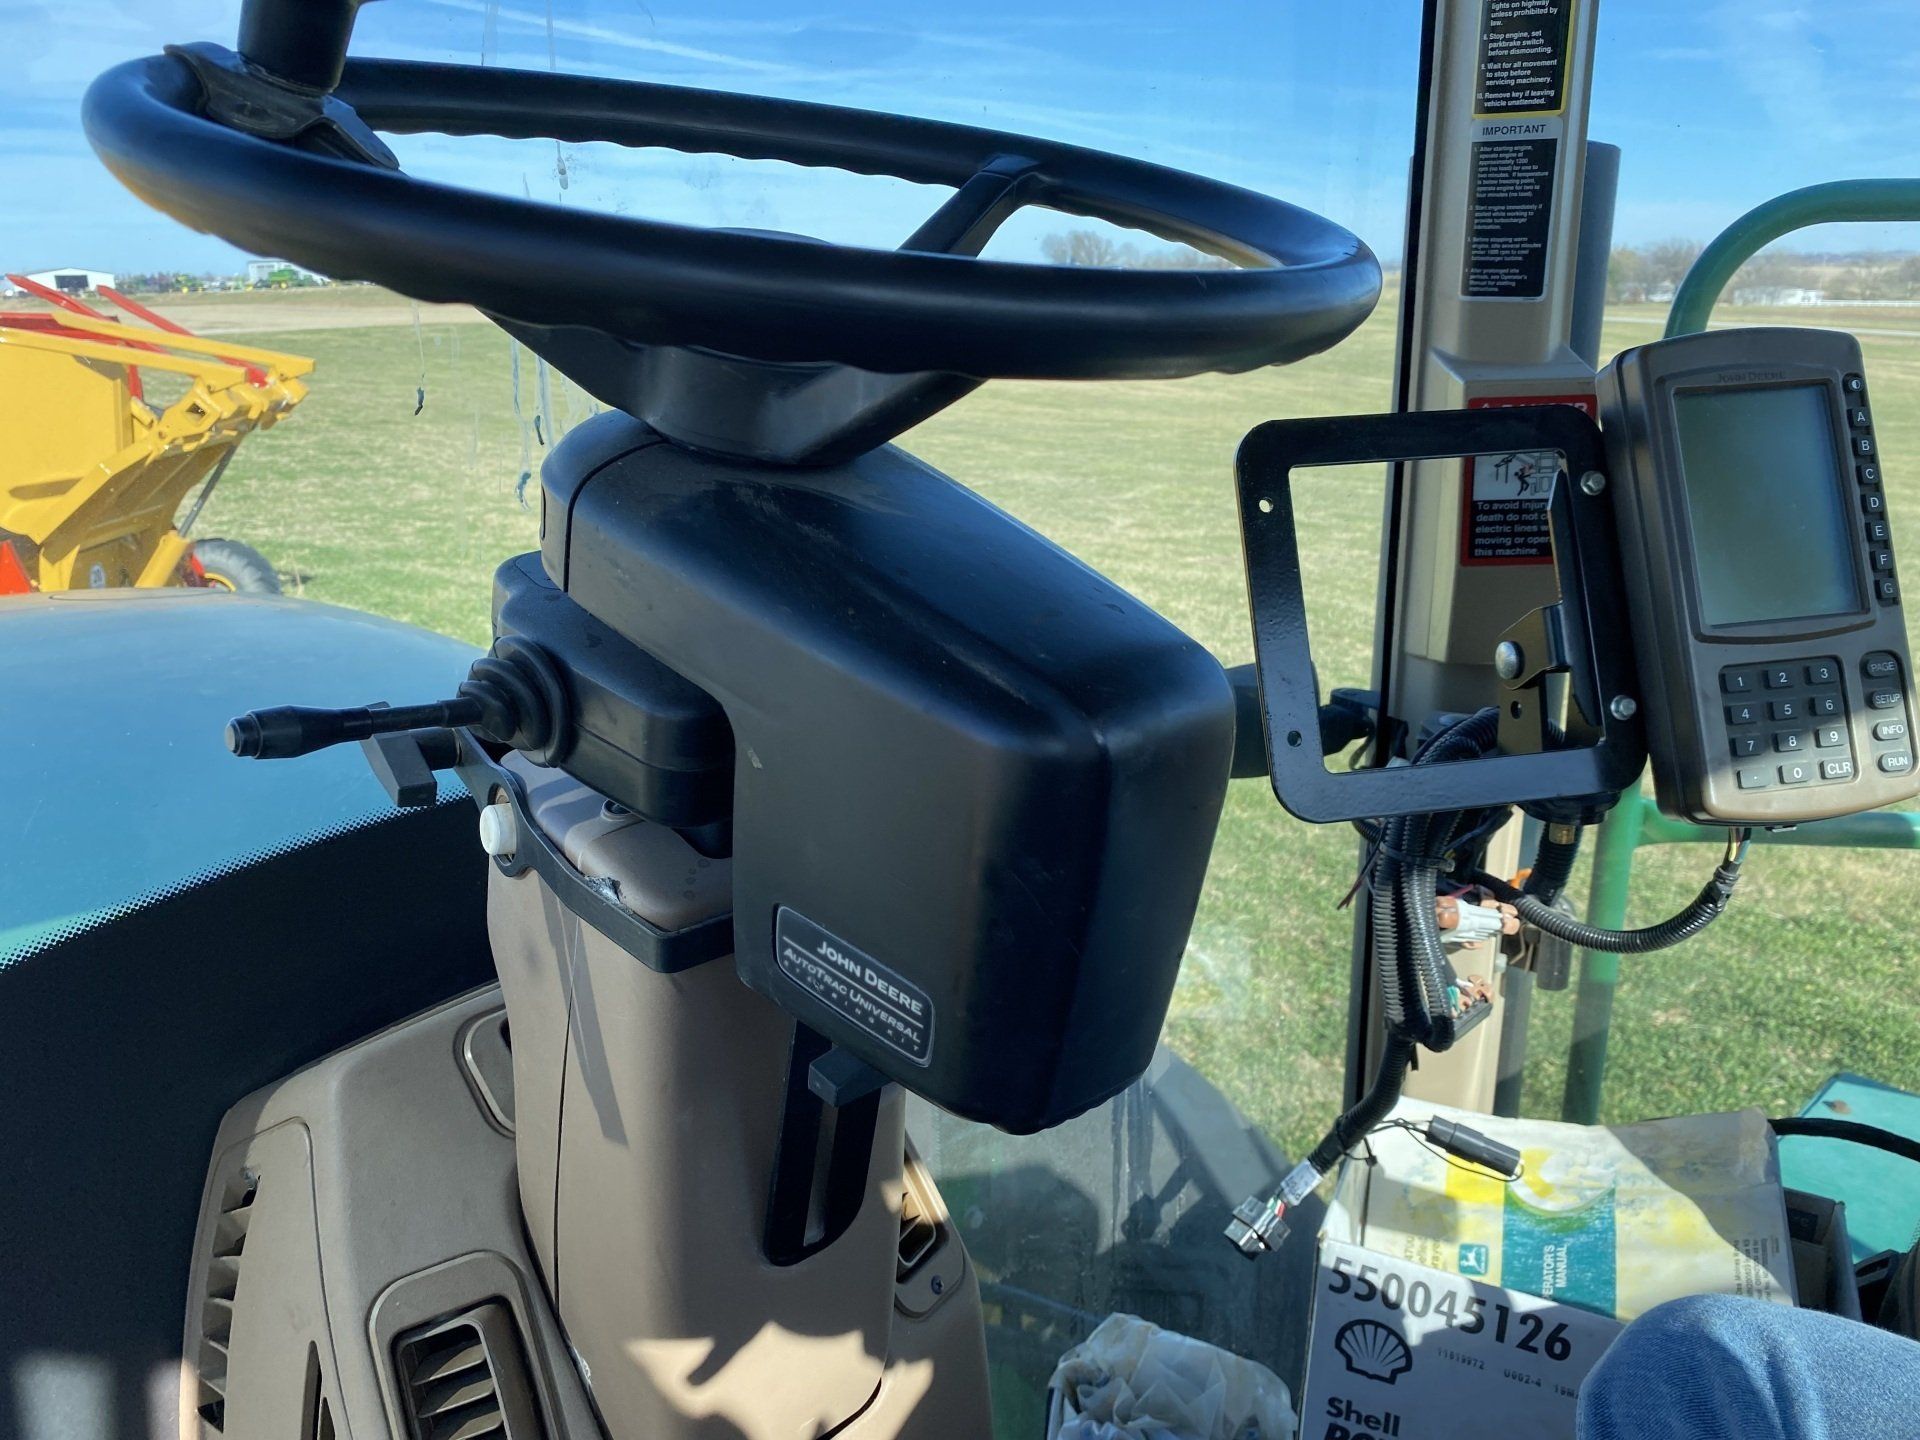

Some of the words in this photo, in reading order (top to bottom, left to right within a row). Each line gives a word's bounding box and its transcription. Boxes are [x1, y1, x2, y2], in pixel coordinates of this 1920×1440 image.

[1492, 2, 1510, 10] lights
[1521, 0, 1550, 8] highway
[1513, 7, 1548, 18] prohibited
[1549, 6, 1559, 15] by
[1489, 32, 1505, 40] Stop
[1488, 40, 1521, 49] parkbrake
[1522, 38, 1544, 46] switch
[1510, 46, 1553, 55] dismounting.
[1502, 61, 1512, 69] for
[1522, 59, 1557, 67] movement
[1509, 69, 1531, 77] before
[1485, 78, 1515, 86] servicing
[1516, 76, 1553, 84] machinery.
[1511, 90, 1524, 99] key
[1530, 88, 1555, 97] leaving
[1484, 99, 1507, 107] vehicle
[1507, 97, 1547, 106] unattended.
[1482, 124, 1547, 136] IMPORTANT
[1857, 411, 1866, 422] A
[1861, 440, 1870, 451] B
[1865, 468, 1874, 479] C
[1477, 501, 1490, 510] To
[1492, 501, 1519, 510] avoid
[1870, 497, 1879, 507] D
[1476, 513, 1504, 521] death
[1506, 513, 1519, 521] do
[1521, 512, 1538, 520] not
[1476, 525, 1512, 533] electric
[1514, 524, 1538, 532] lines
[1875, 525, 1884, 536] E
[1475, 536, 1512, 546] moving
[1474, 548, 1493, 556] this
[1495, 546, 1539, 556] machine.
[1879, 554, 1888, 565] F
[1884, 583, 1893, 594] G
[1870, 661, 1896, 672] PAGE
[1779, 672, 1788, 683] 2
[1820, 667, 1829, 679] 3
[1737, 676, 1744, 687] 1
[1875, 693, 1900, 704] SETUP
[1784, 704, 1792, 715] 5
[1825, 699, 1834, 711] 6
[1741, 708, 1750, 719] 4
[1882, 724, 1904, 735] INFO
[1788, 735, 1797, 747] 8
[1829, 730, 1839, 742] 9
[1747, 740, 1755, 751] 7
[1887, 756, 1908, 767] RUN
[1793, 767, 1803, 779] 0
[1827, 761, 1852, 775] CLR
[817, 941, 861, 978] JOHN
[864, 968, 922, 1016] DEERE
[783, 948, 847, 995] AUTOTRAC
[850, 989, 921, 1043] UNIVERSAL
[1555, 1243, 1568, 1288] MANUAL
[1328, 1256, 1572, 1361] 550045126
[1326, 1396, 1400, 1437] Shell
